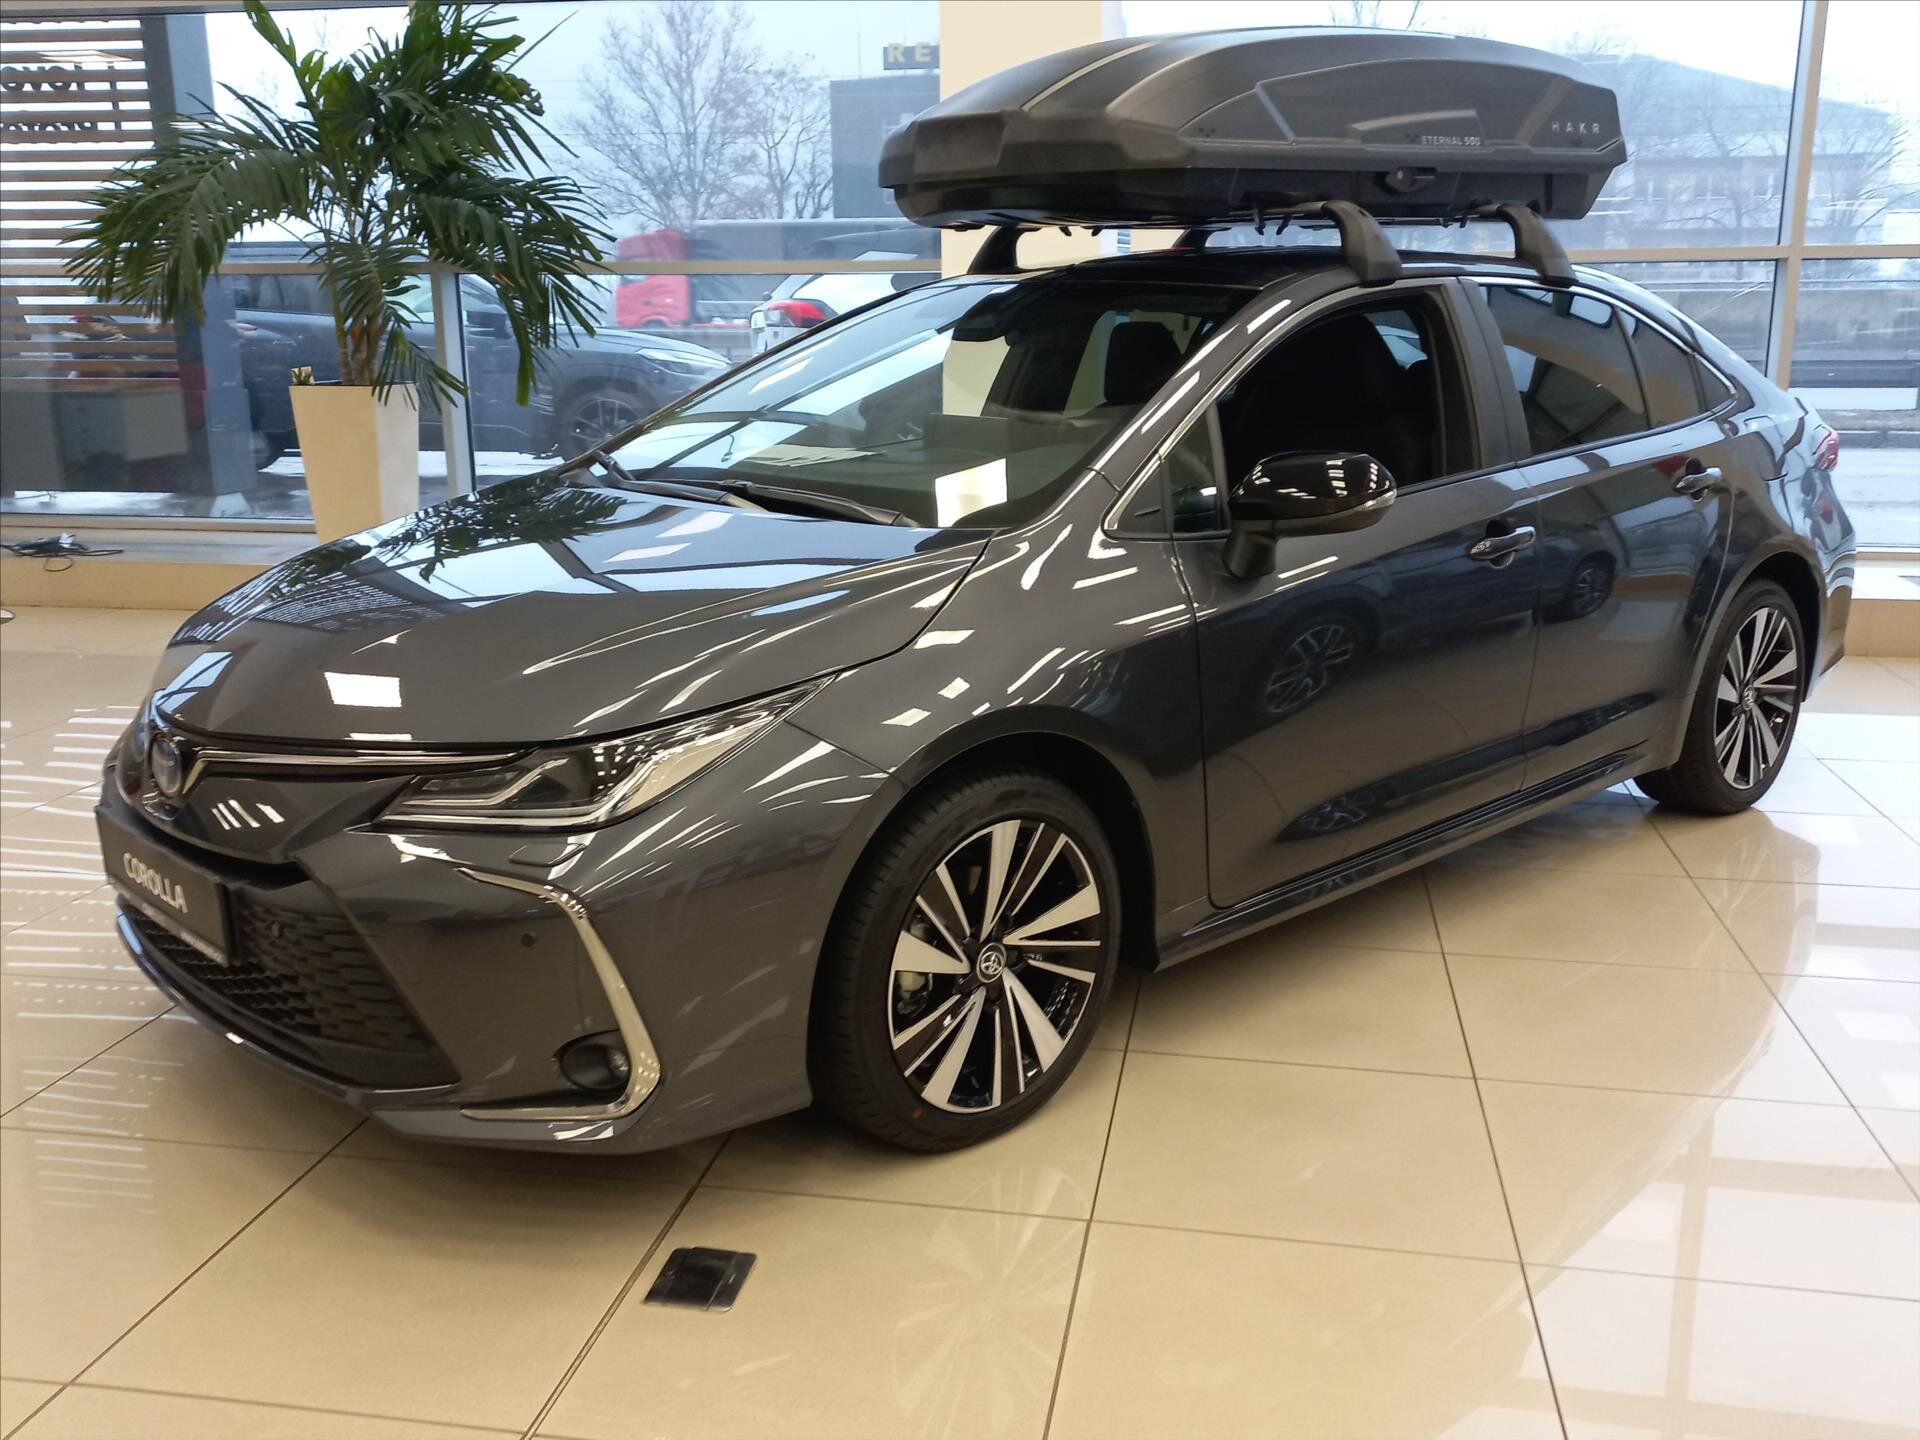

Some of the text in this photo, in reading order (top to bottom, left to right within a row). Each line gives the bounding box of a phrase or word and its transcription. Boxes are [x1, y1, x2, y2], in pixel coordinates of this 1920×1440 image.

[1551, 121, 1600, 134] HAKR
[1422, 135, 1463, 145] ETERNAL
[123, 852, 188, 914] COROLLA
